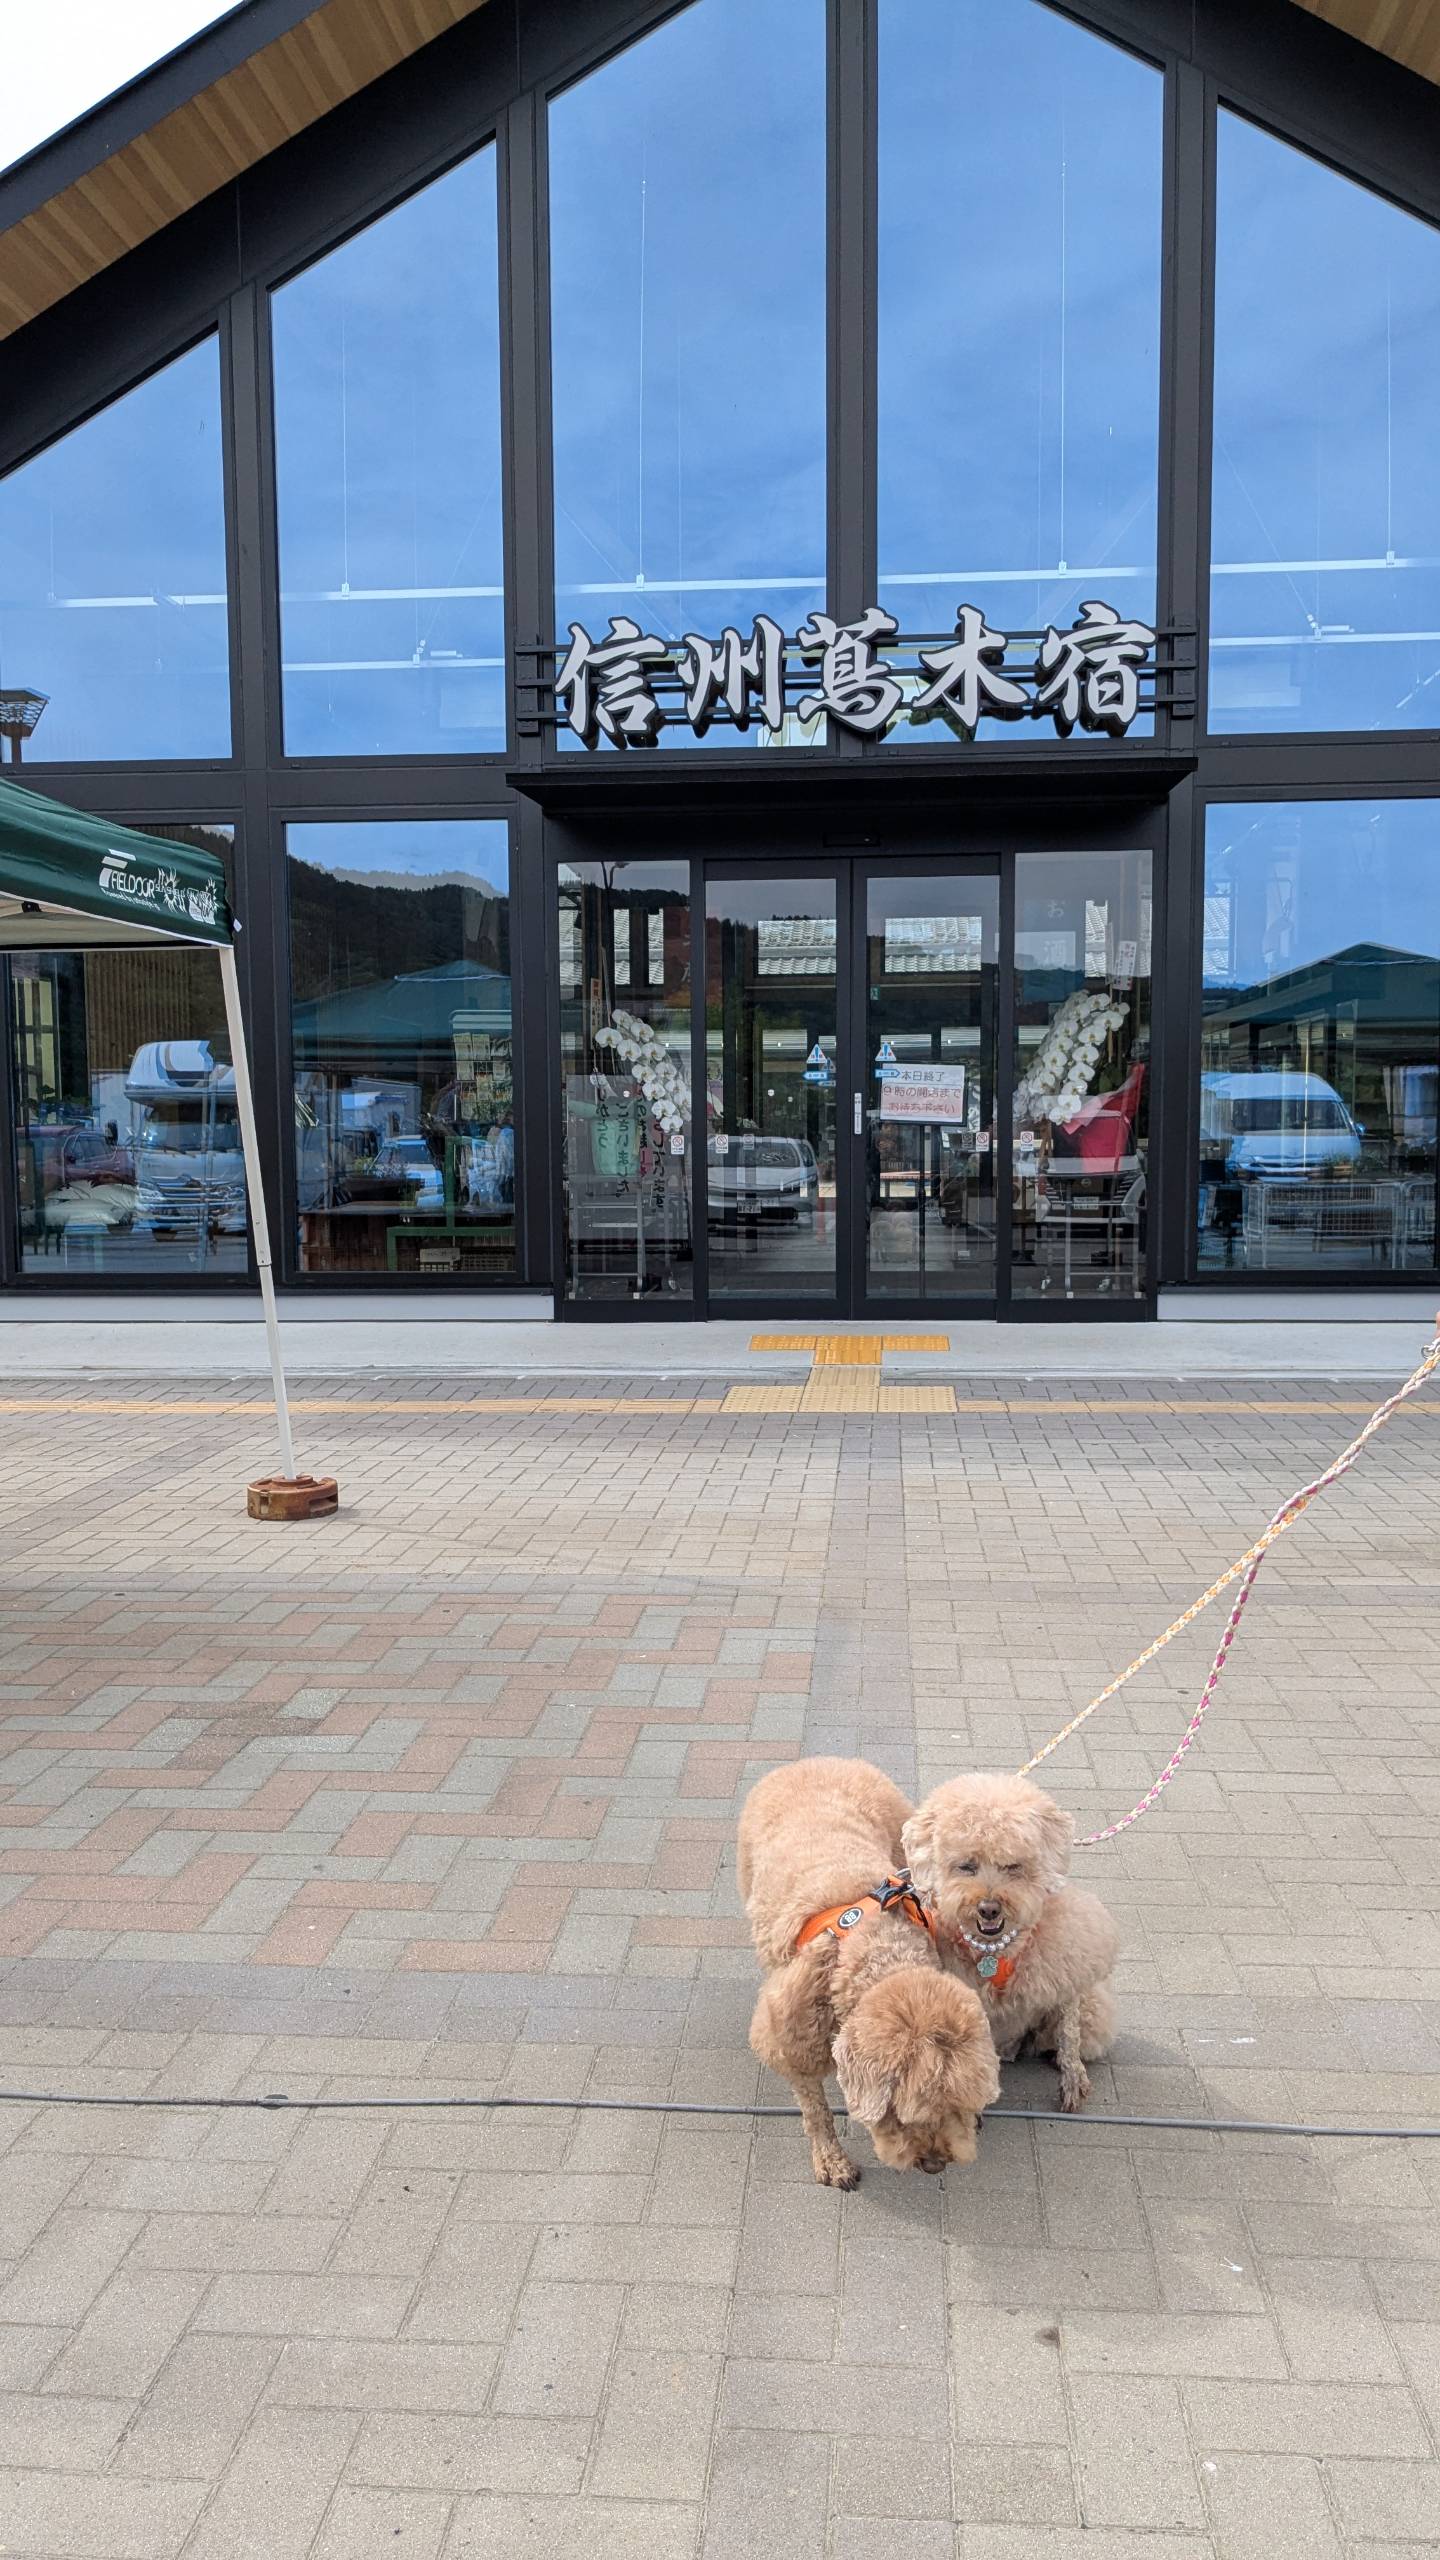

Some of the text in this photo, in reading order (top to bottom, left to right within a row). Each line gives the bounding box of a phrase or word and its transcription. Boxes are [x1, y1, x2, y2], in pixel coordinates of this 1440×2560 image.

[555, 602, 1156, 736] 信州蔦木宿
[901, 1070, 945, 1082] 本日終了
